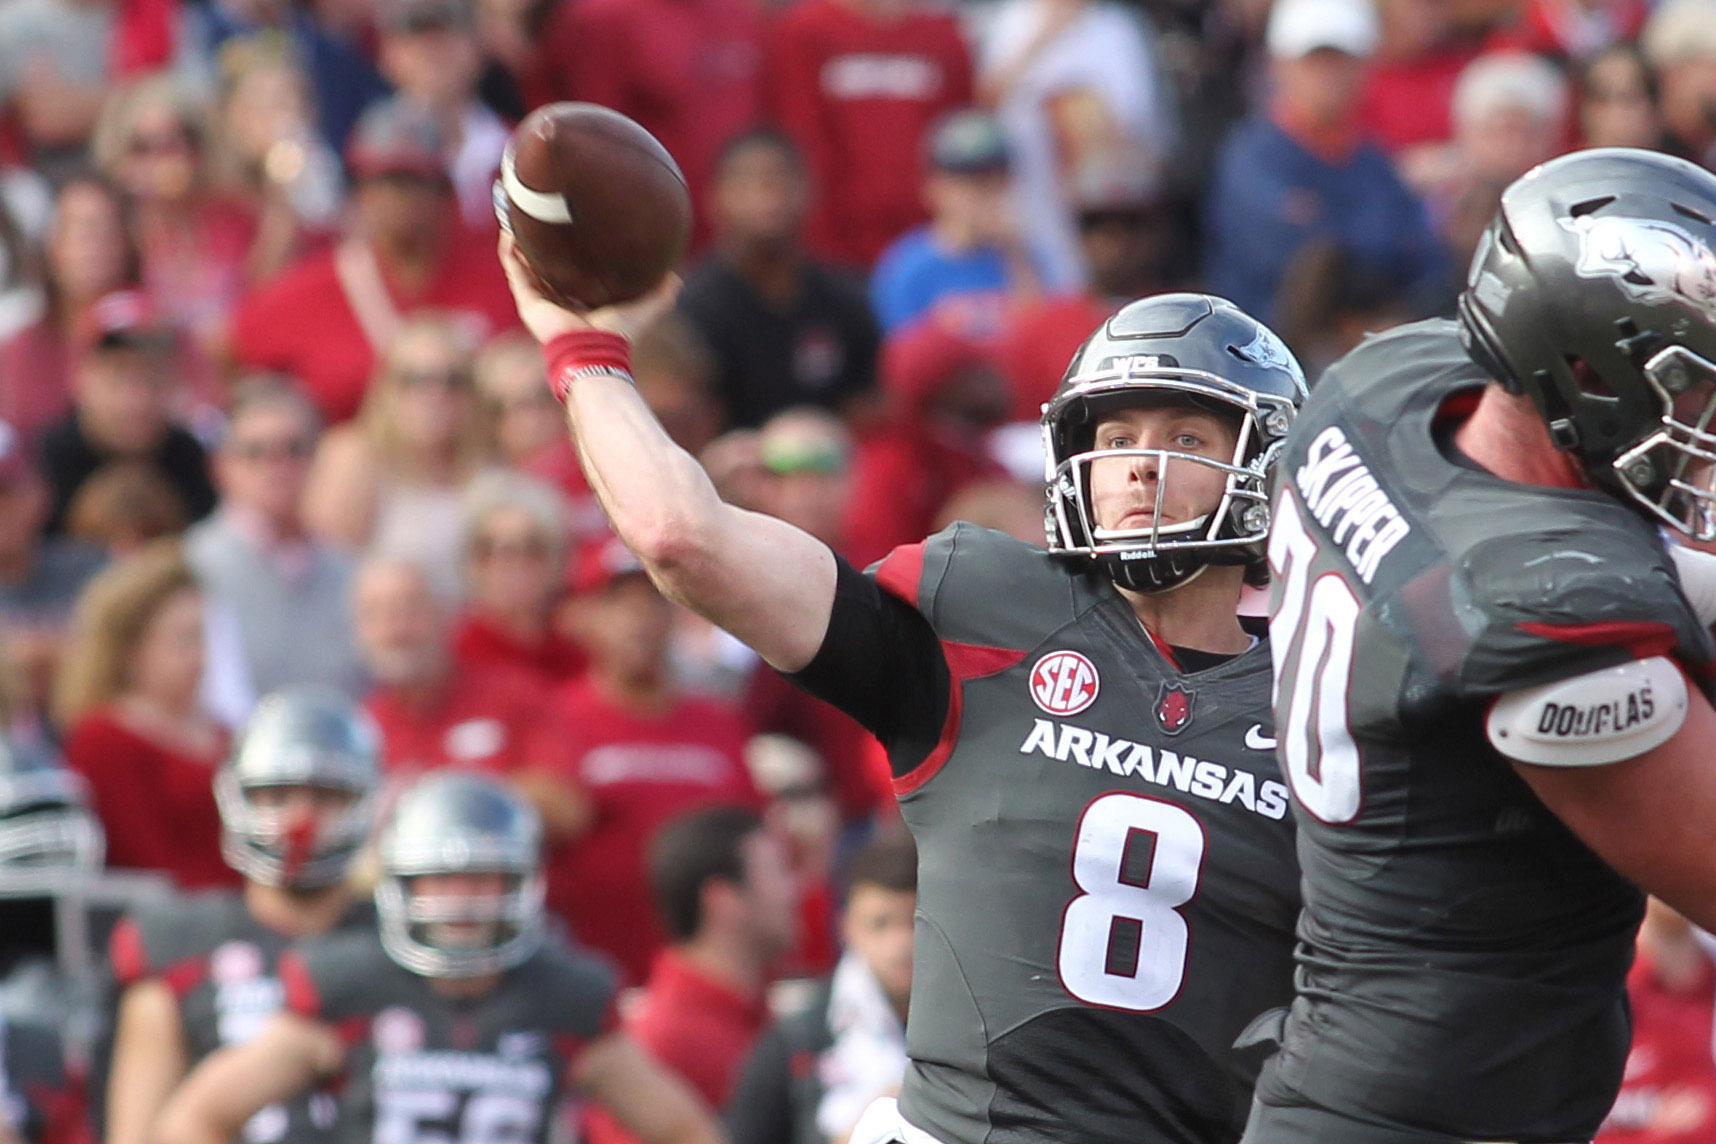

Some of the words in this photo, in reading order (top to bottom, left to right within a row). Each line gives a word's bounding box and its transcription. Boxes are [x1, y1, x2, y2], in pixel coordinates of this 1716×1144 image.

[1296, 426, 1411, 585] SKIPPER
[1034, 654, 1096, 710] SEC
[1267, 484, 1364, 825] 70
[1019, 718, 1290, 820] ARKANSAS
[1055, 789, 1210, 1014] 8
